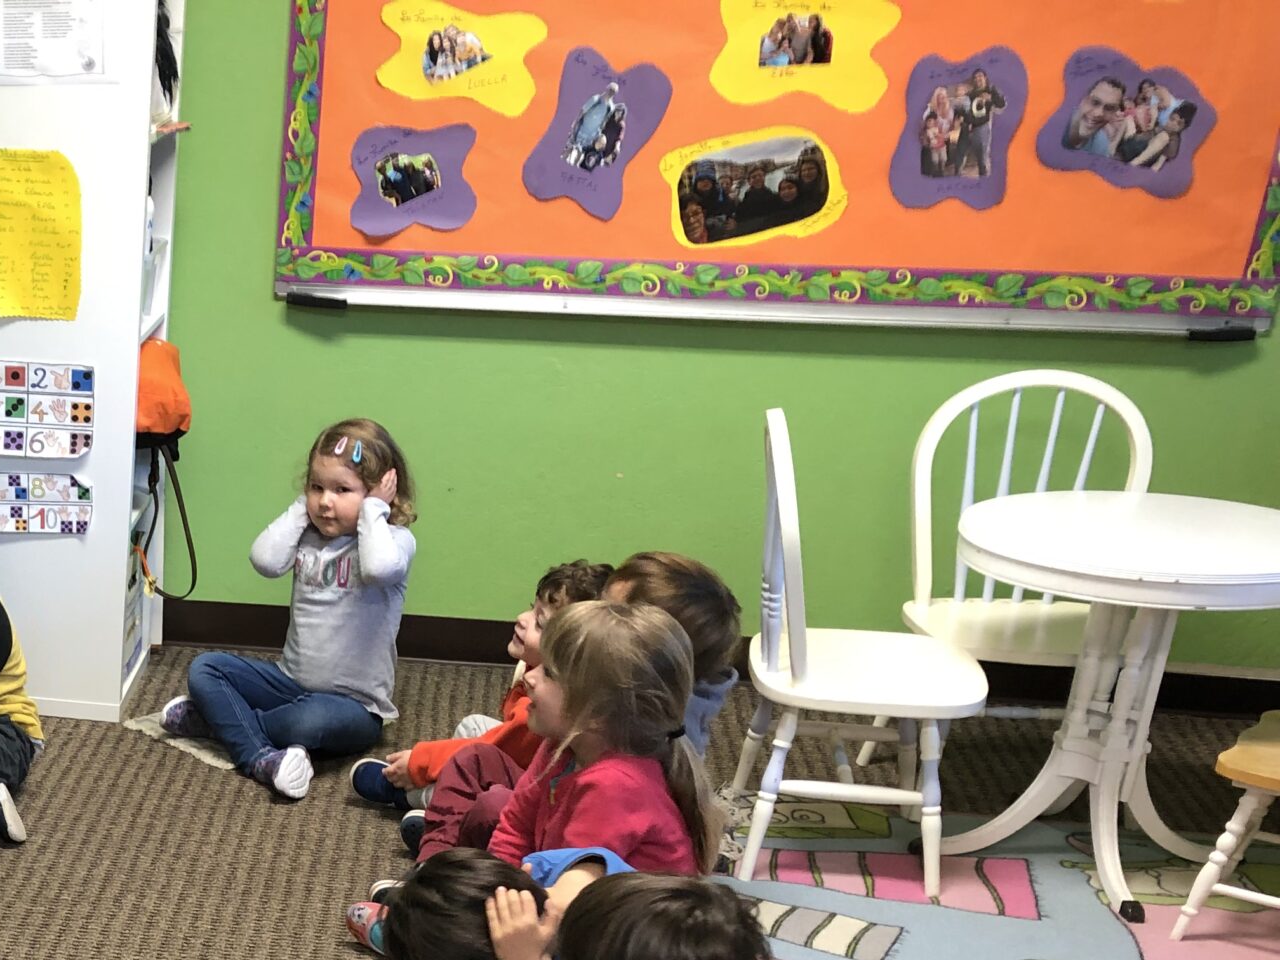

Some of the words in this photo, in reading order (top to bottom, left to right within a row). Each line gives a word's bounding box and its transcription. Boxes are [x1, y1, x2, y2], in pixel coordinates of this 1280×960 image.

[30, 367, 48, 389] 2
[30, 401, 49, 423] 4
[29, 431, 45, 454] 6
[31, 477, 46, 499] 8
[30, 507, 58, 530] 10
